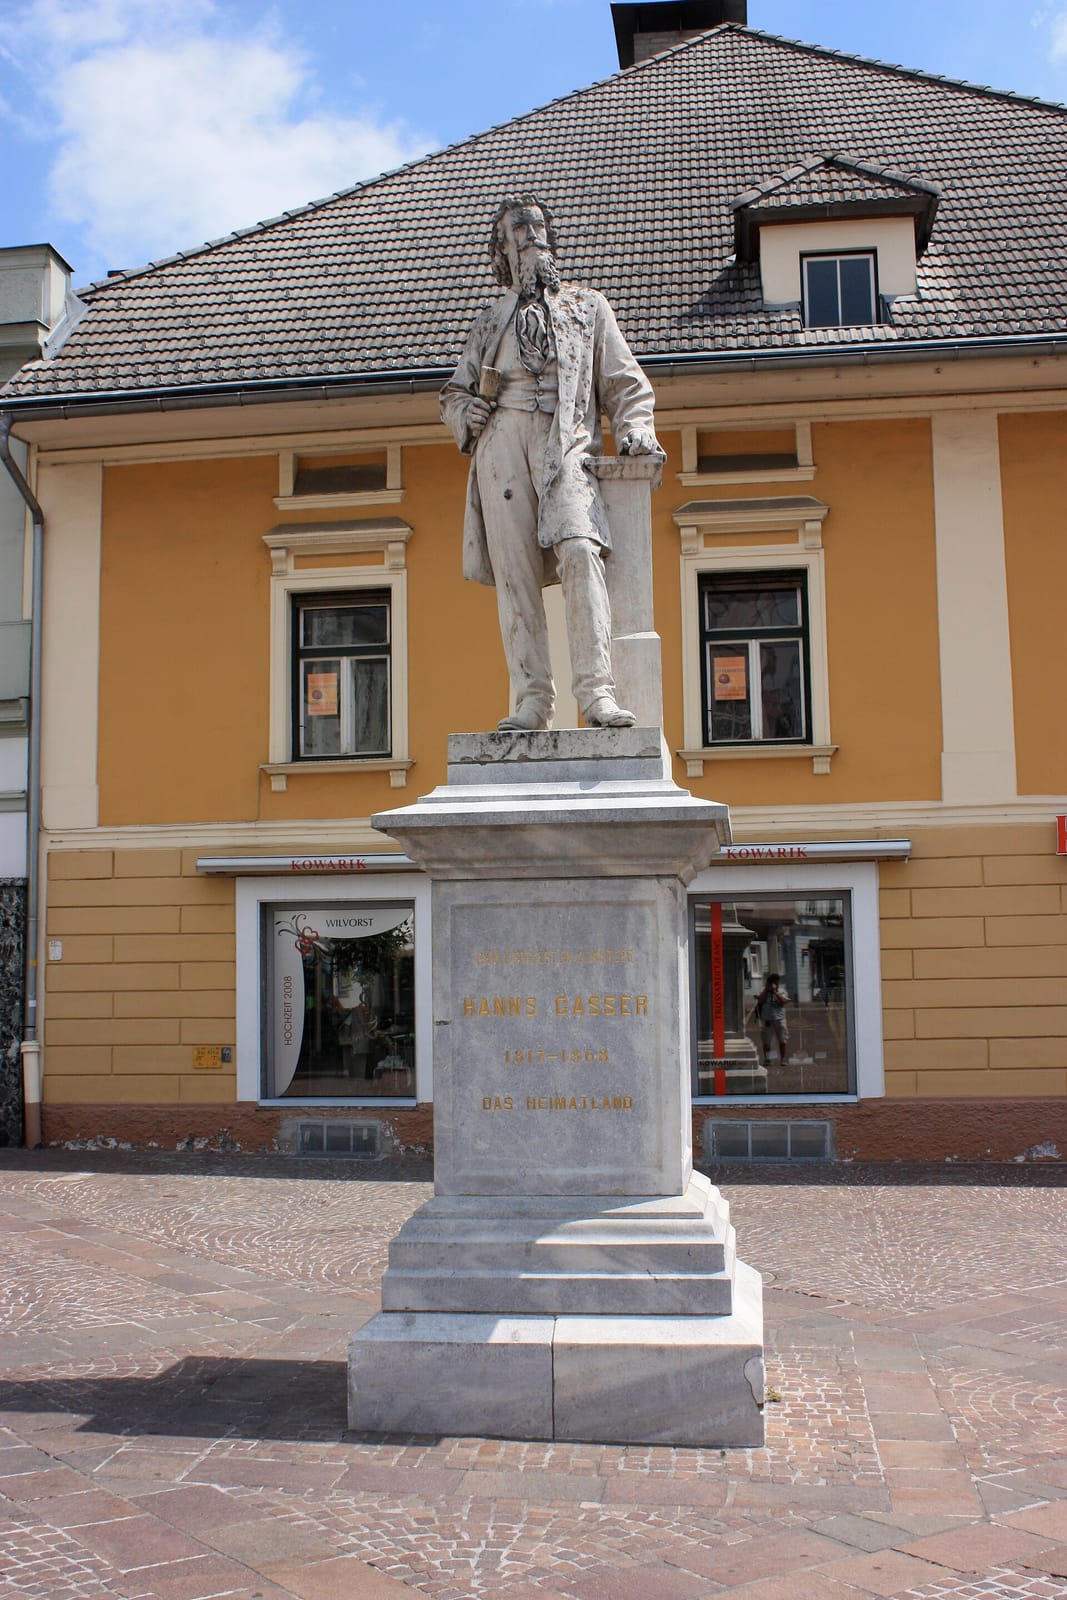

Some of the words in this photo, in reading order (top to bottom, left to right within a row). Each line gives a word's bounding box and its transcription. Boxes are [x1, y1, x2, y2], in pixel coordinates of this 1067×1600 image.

[727, 847, 808, 859] KOWARIK
[291, 859, 368, 870] KOWARIK
[325, 918, 374, 927] WILVORST
[283, 975, 293, 999] 2008
[463, 996, 537, 1017] HANNS
[283, 1001, 293, 1046] HOCHZEIT
[482, 1096, 514, 1111] DAS
[526, 1096, 634, 1111] HEIMATLAND
